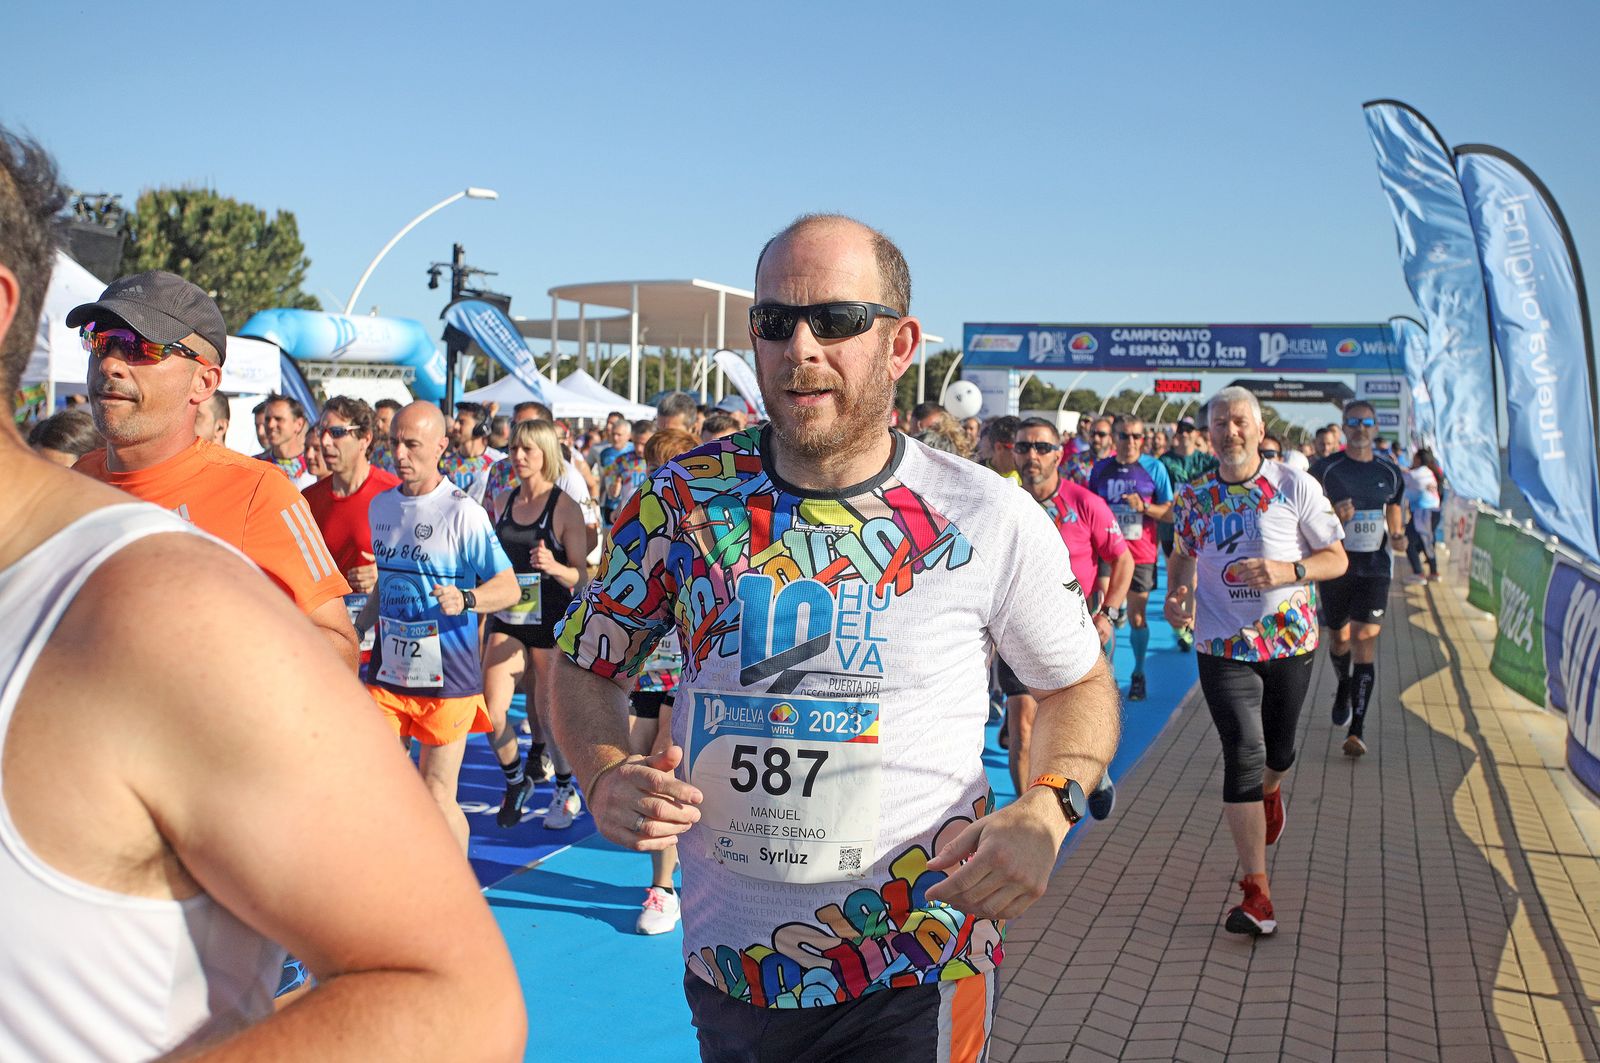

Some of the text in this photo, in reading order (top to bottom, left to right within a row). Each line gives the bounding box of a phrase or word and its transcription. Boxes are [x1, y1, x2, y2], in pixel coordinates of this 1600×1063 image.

[1111, 328, 1212, 342] CAMPEONATO
[1110, 341, 1247, 359] de ESPAÑA 10 km
[1259, 332, 1287, 366] 10
[1287, 338, 1328, 354] HUELVA
[1354, 522, 1377, 533] 880
[373, 540, 397, 564] Stop
[411, 545, 430, 562] Go
[838, 583, 893, 612] HU
[1228, 588, 1261, 600] WiHu
[737, 573, 835, 687] 10
[835, 610, 888, 642] EL
[392, 637, 422, 658] 772
[835, 639, 885, 673] VA
[829, 677, 863, 693] PUERTA
[703, 697, 726, 735] 10
[725, 706, 765, 724] HUELVA
[808, 710, 862, 735] 2023
[771, 725, 795, 735] WiHu
[729, 744, 829, 798] 587
[750, 806, 801, 821] MANUEL
[729, 818, 827, 840] ÁLVAREZ SENAO
[714, 843, 749, 864] UNDAI
[759, 846, 808, 866] Syrluz
